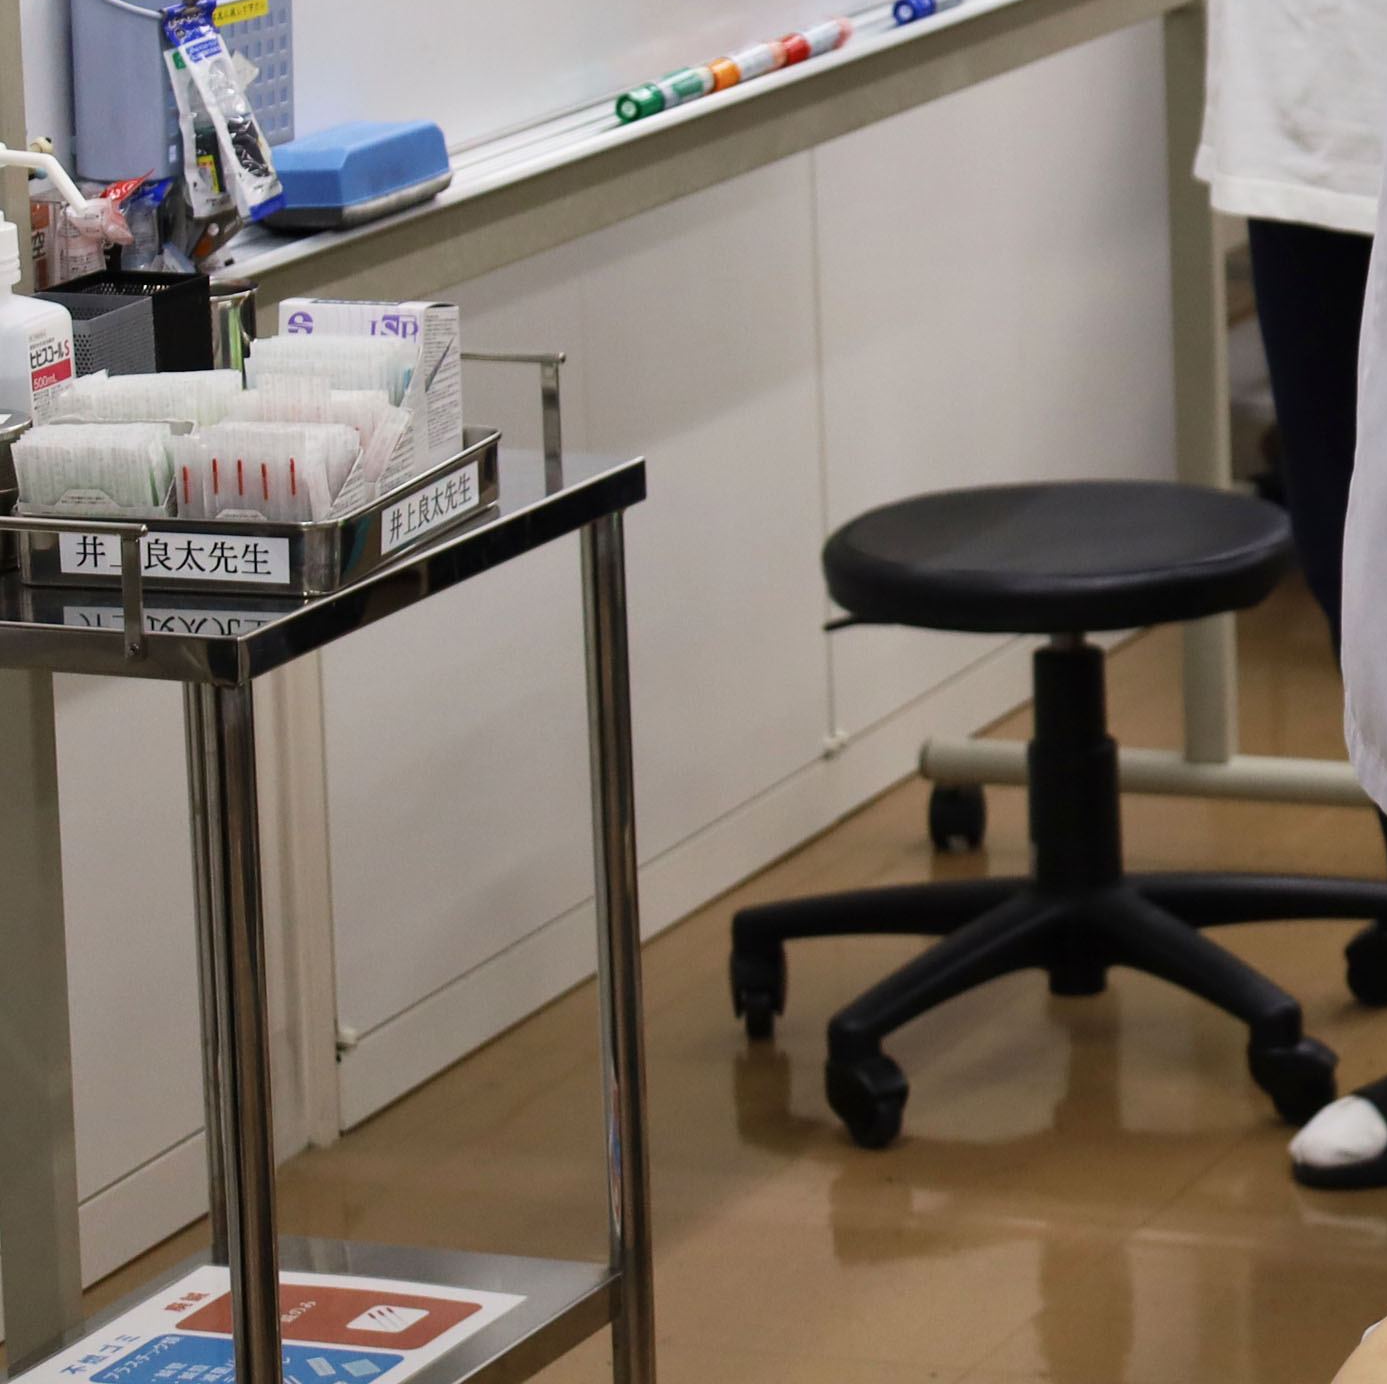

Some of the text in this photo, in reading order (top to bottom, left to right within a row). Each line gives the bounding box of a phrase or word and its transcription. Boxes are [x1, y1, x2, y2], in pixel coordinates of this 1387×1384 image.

[389, 472, 472, 545] 井上良太先生
